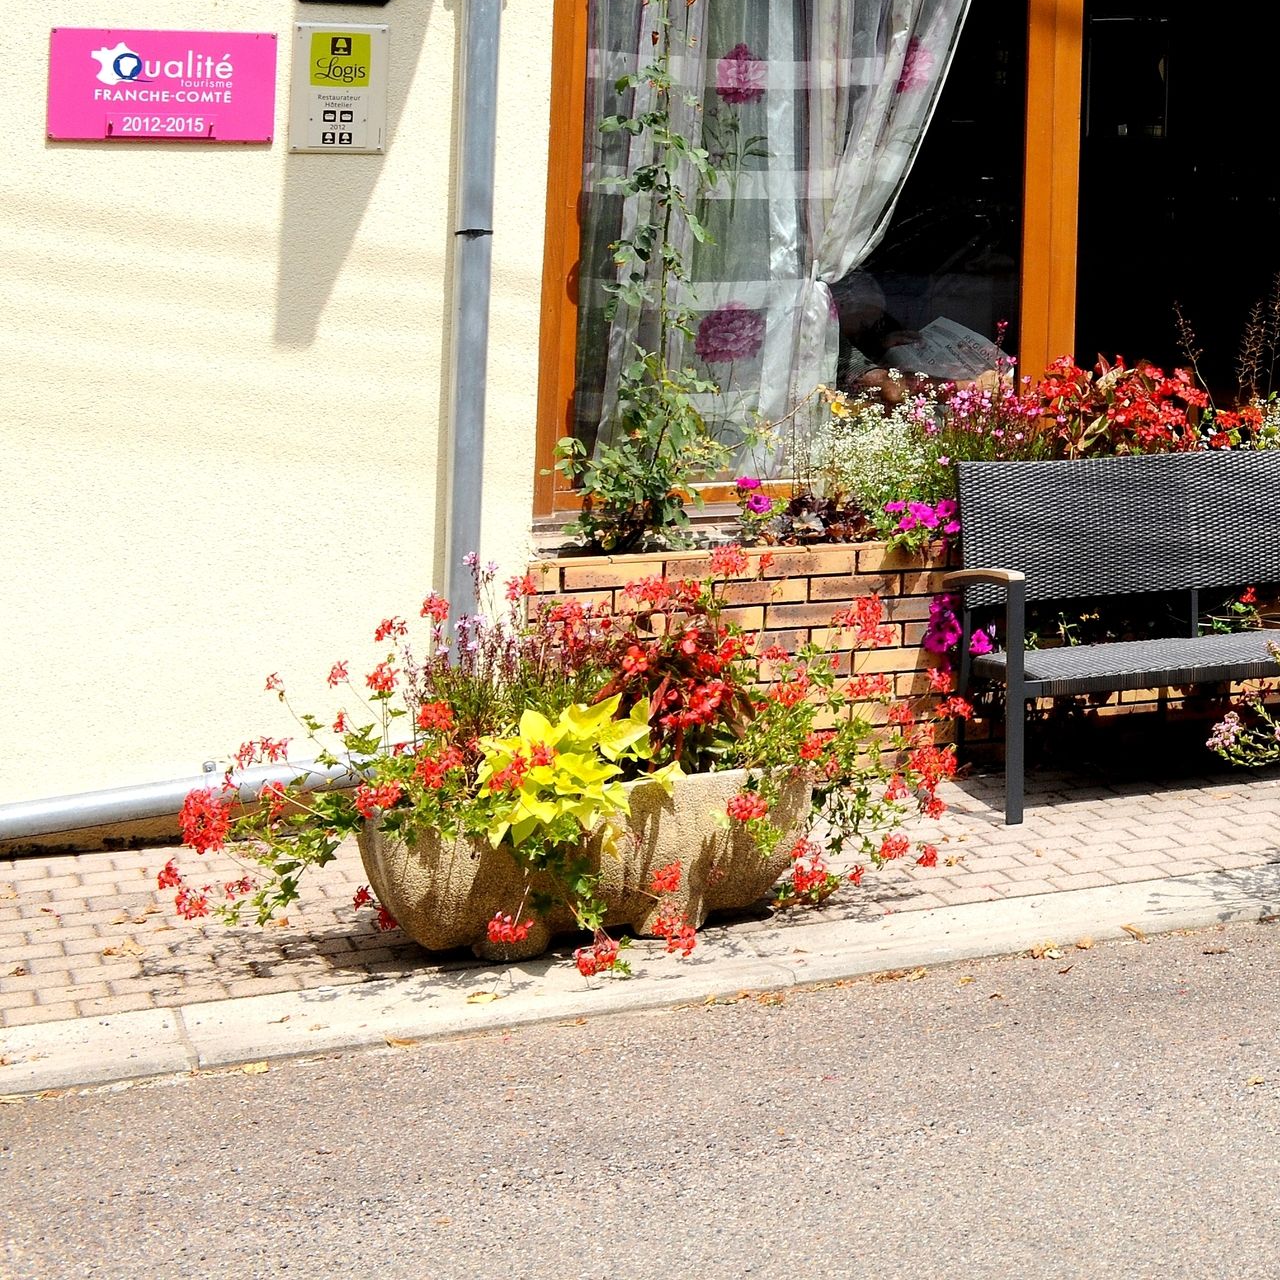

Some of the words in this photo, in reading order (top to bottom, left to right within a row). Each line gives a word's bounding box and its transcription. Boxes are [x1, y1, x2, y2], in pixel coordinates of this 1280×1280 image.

[112, 50, 233, 83] Qualité
[314, 56, 366, 83] Logis
[181, 79, 233, 88] tourisme
[122, 116, 204, 132] 2012-2015
